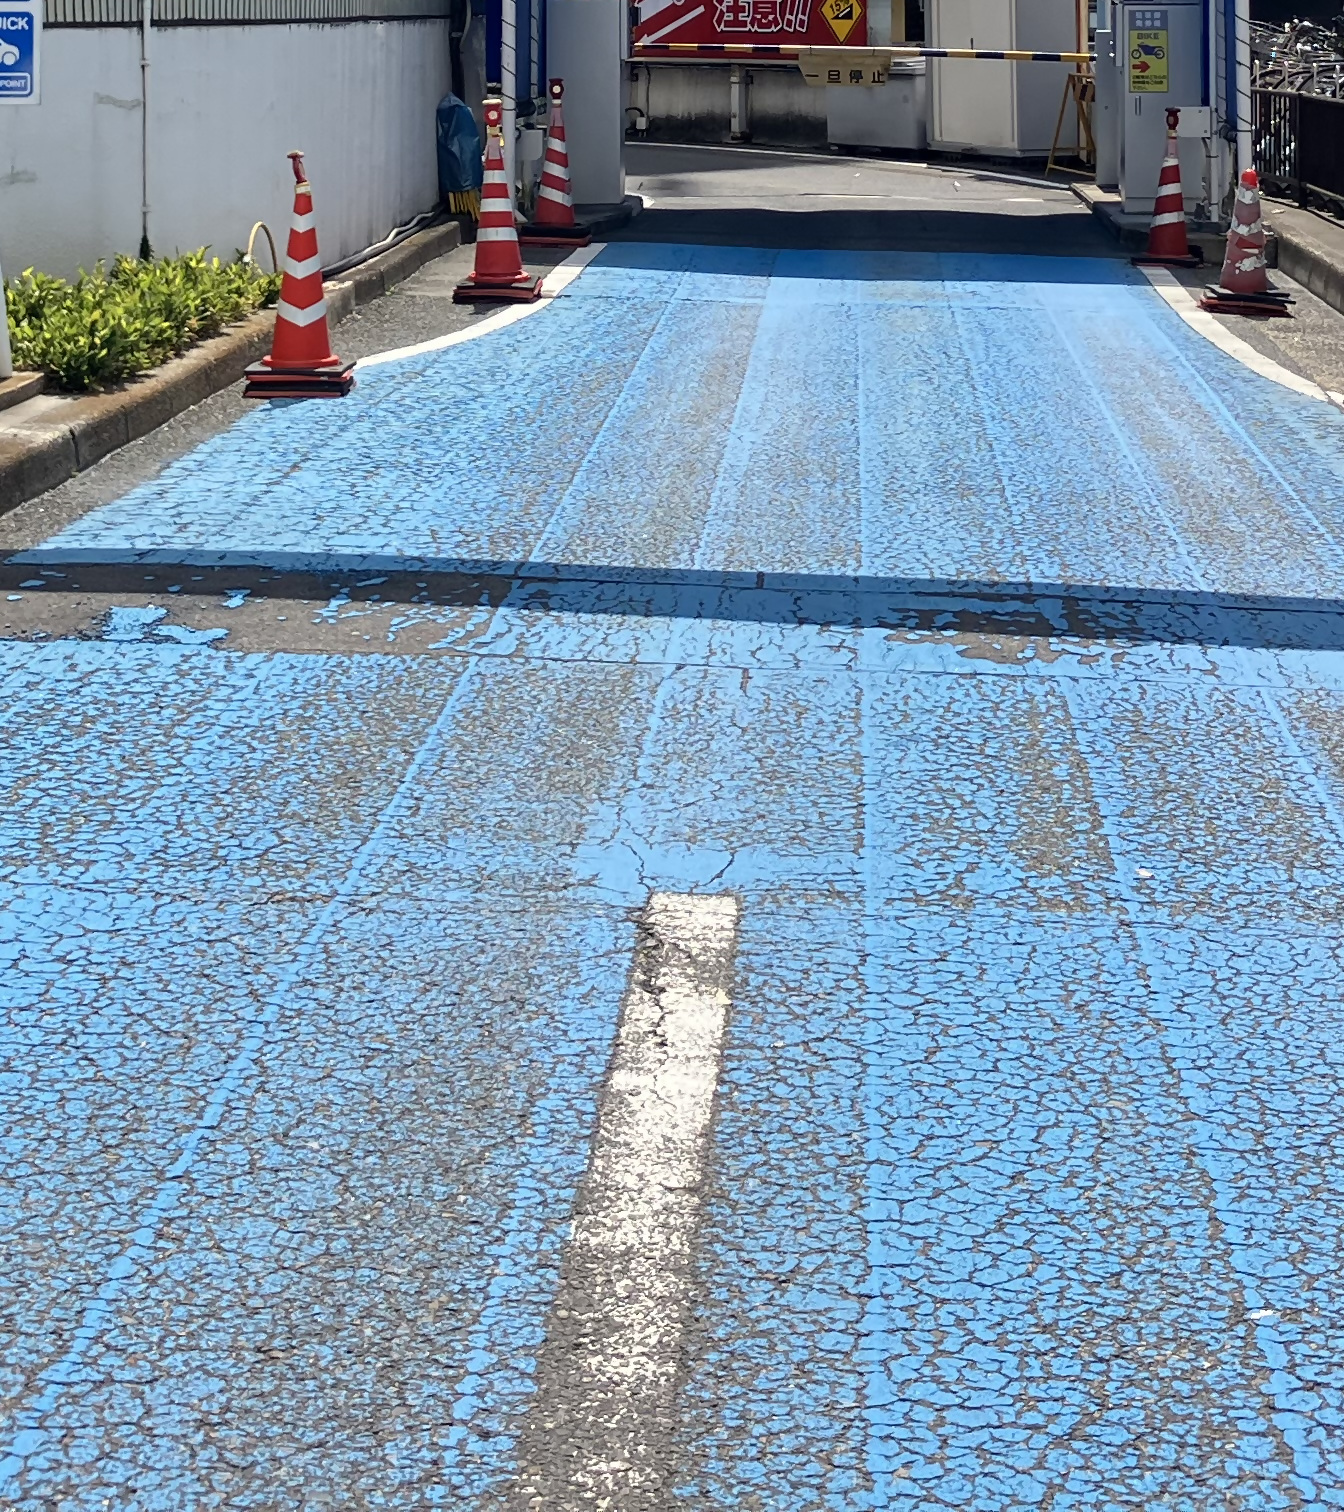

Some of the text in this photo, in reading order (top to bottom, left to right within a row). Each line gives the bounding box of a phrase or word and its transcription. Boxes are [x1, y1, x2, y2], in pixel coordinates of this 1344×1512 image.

[1137, 32, 1160, 40] BIKE
[805, 69, 886, 84] 一旦停止
[0, 78, 27, 88] POINT
